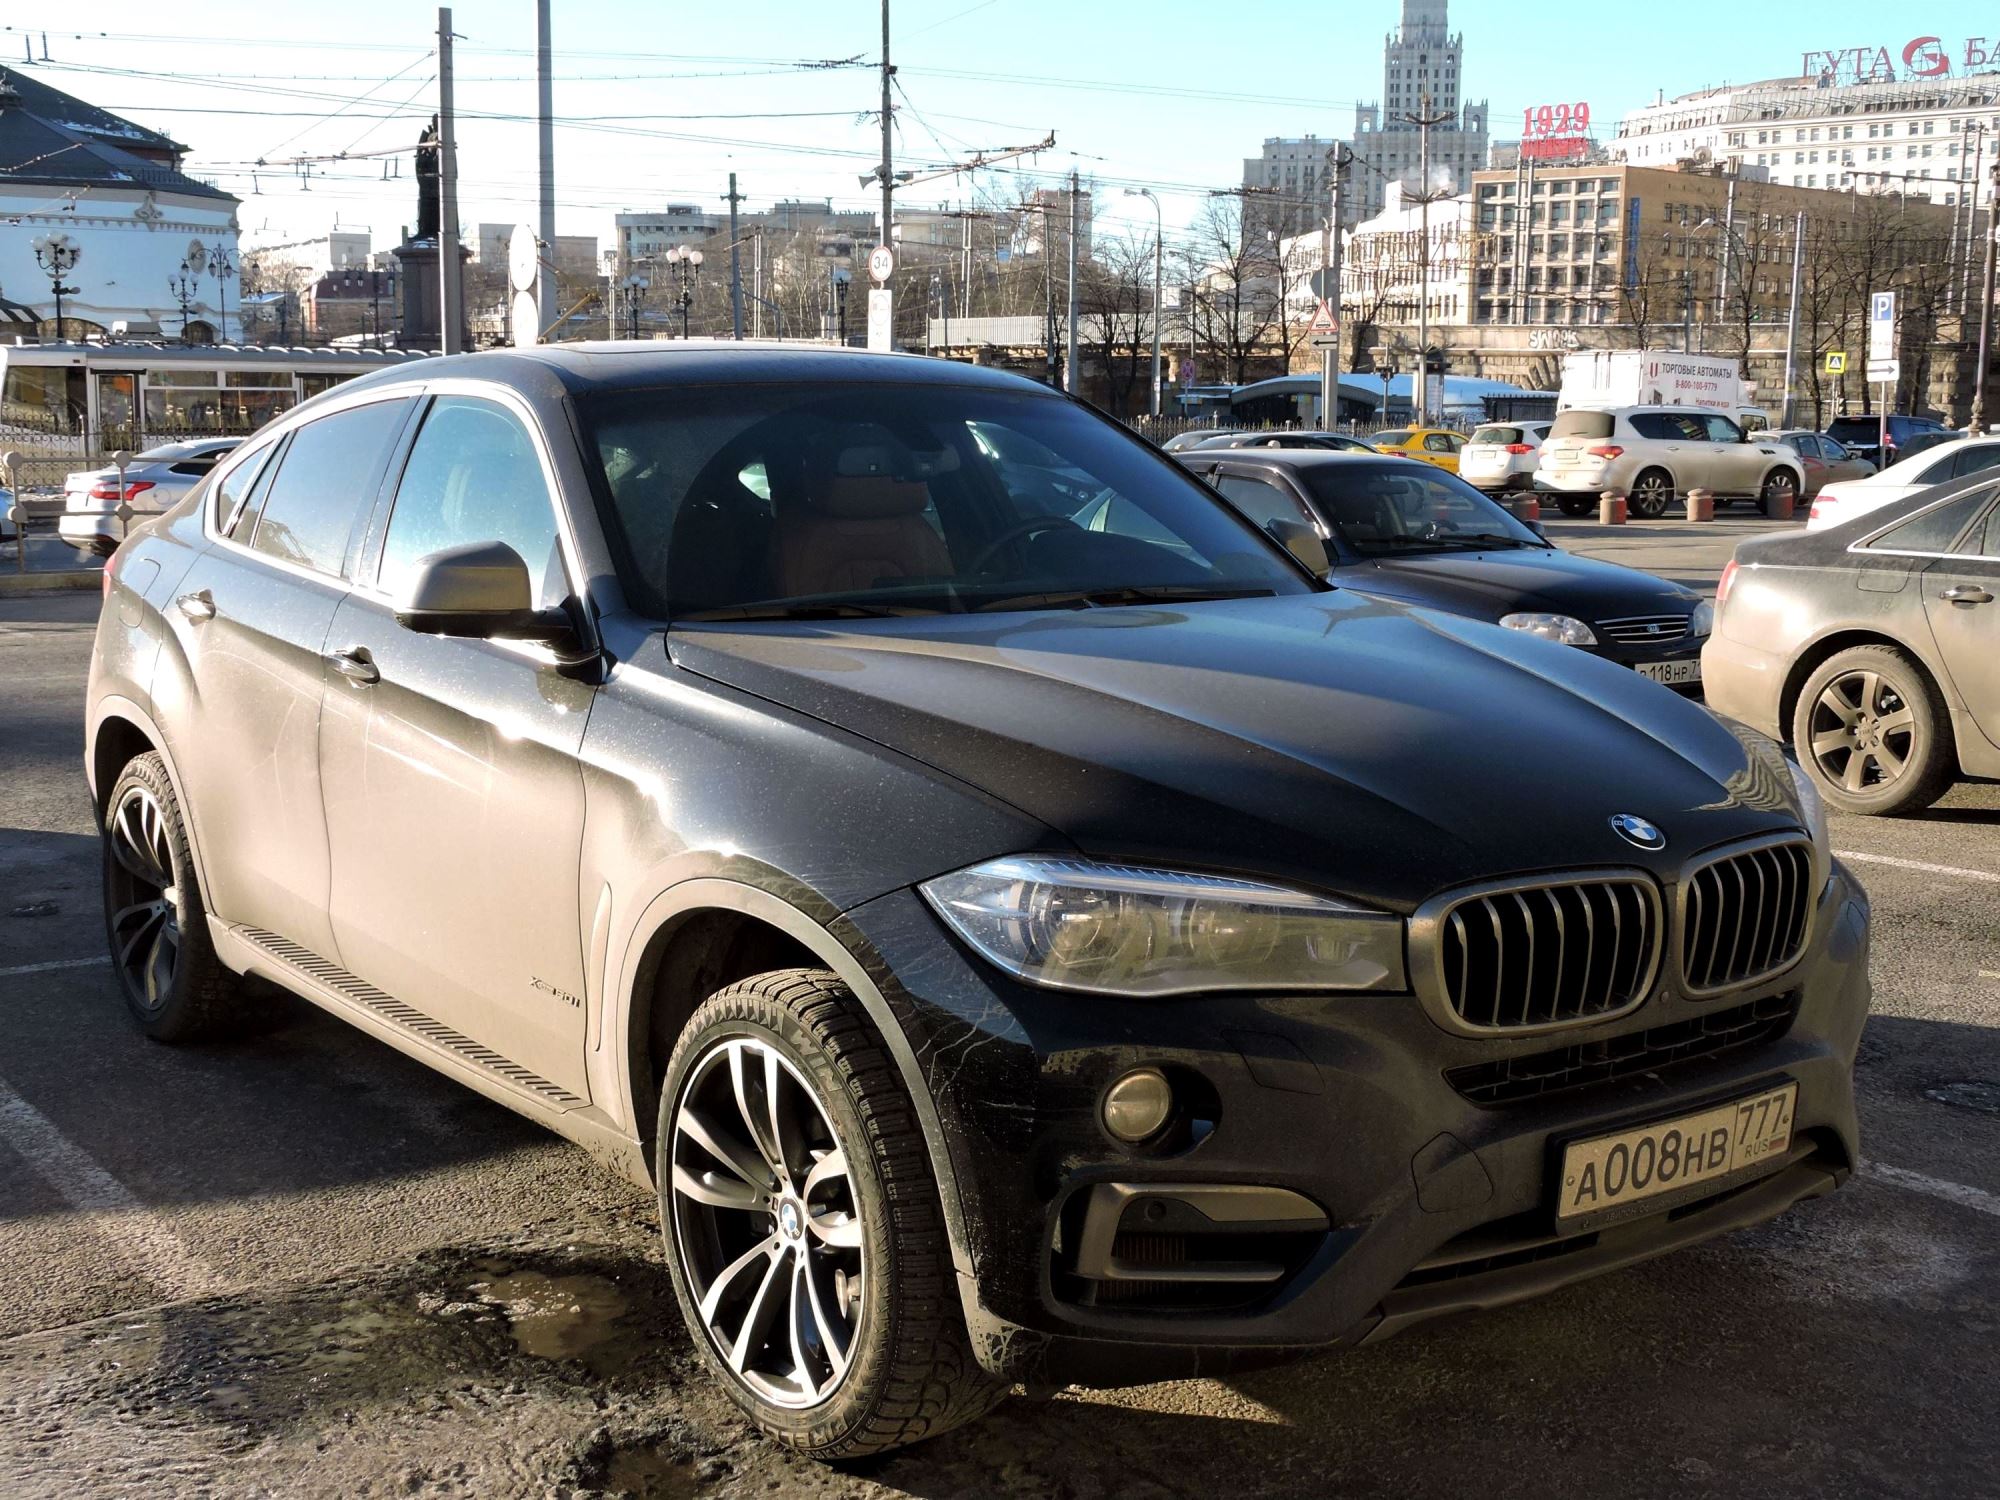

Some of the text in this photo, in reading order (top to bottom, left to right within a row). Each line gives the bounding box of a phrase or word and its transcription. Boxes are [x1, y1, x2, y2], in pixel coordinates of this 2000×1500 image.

[1802, 46, 1895, 79] ГУТА
[1522, 102, 1589, 137] 1929
[1877, 297, 1890, 320] P
[1662, 363, 1732, 379] ТОРГОВЫЕ АВТОМАТЫ
[1739, 1093, 1787, 1145] 777
[1745, 1137, 1769, 1158] RUS
[1574, 1127, 1728, 1206] А008НВ
